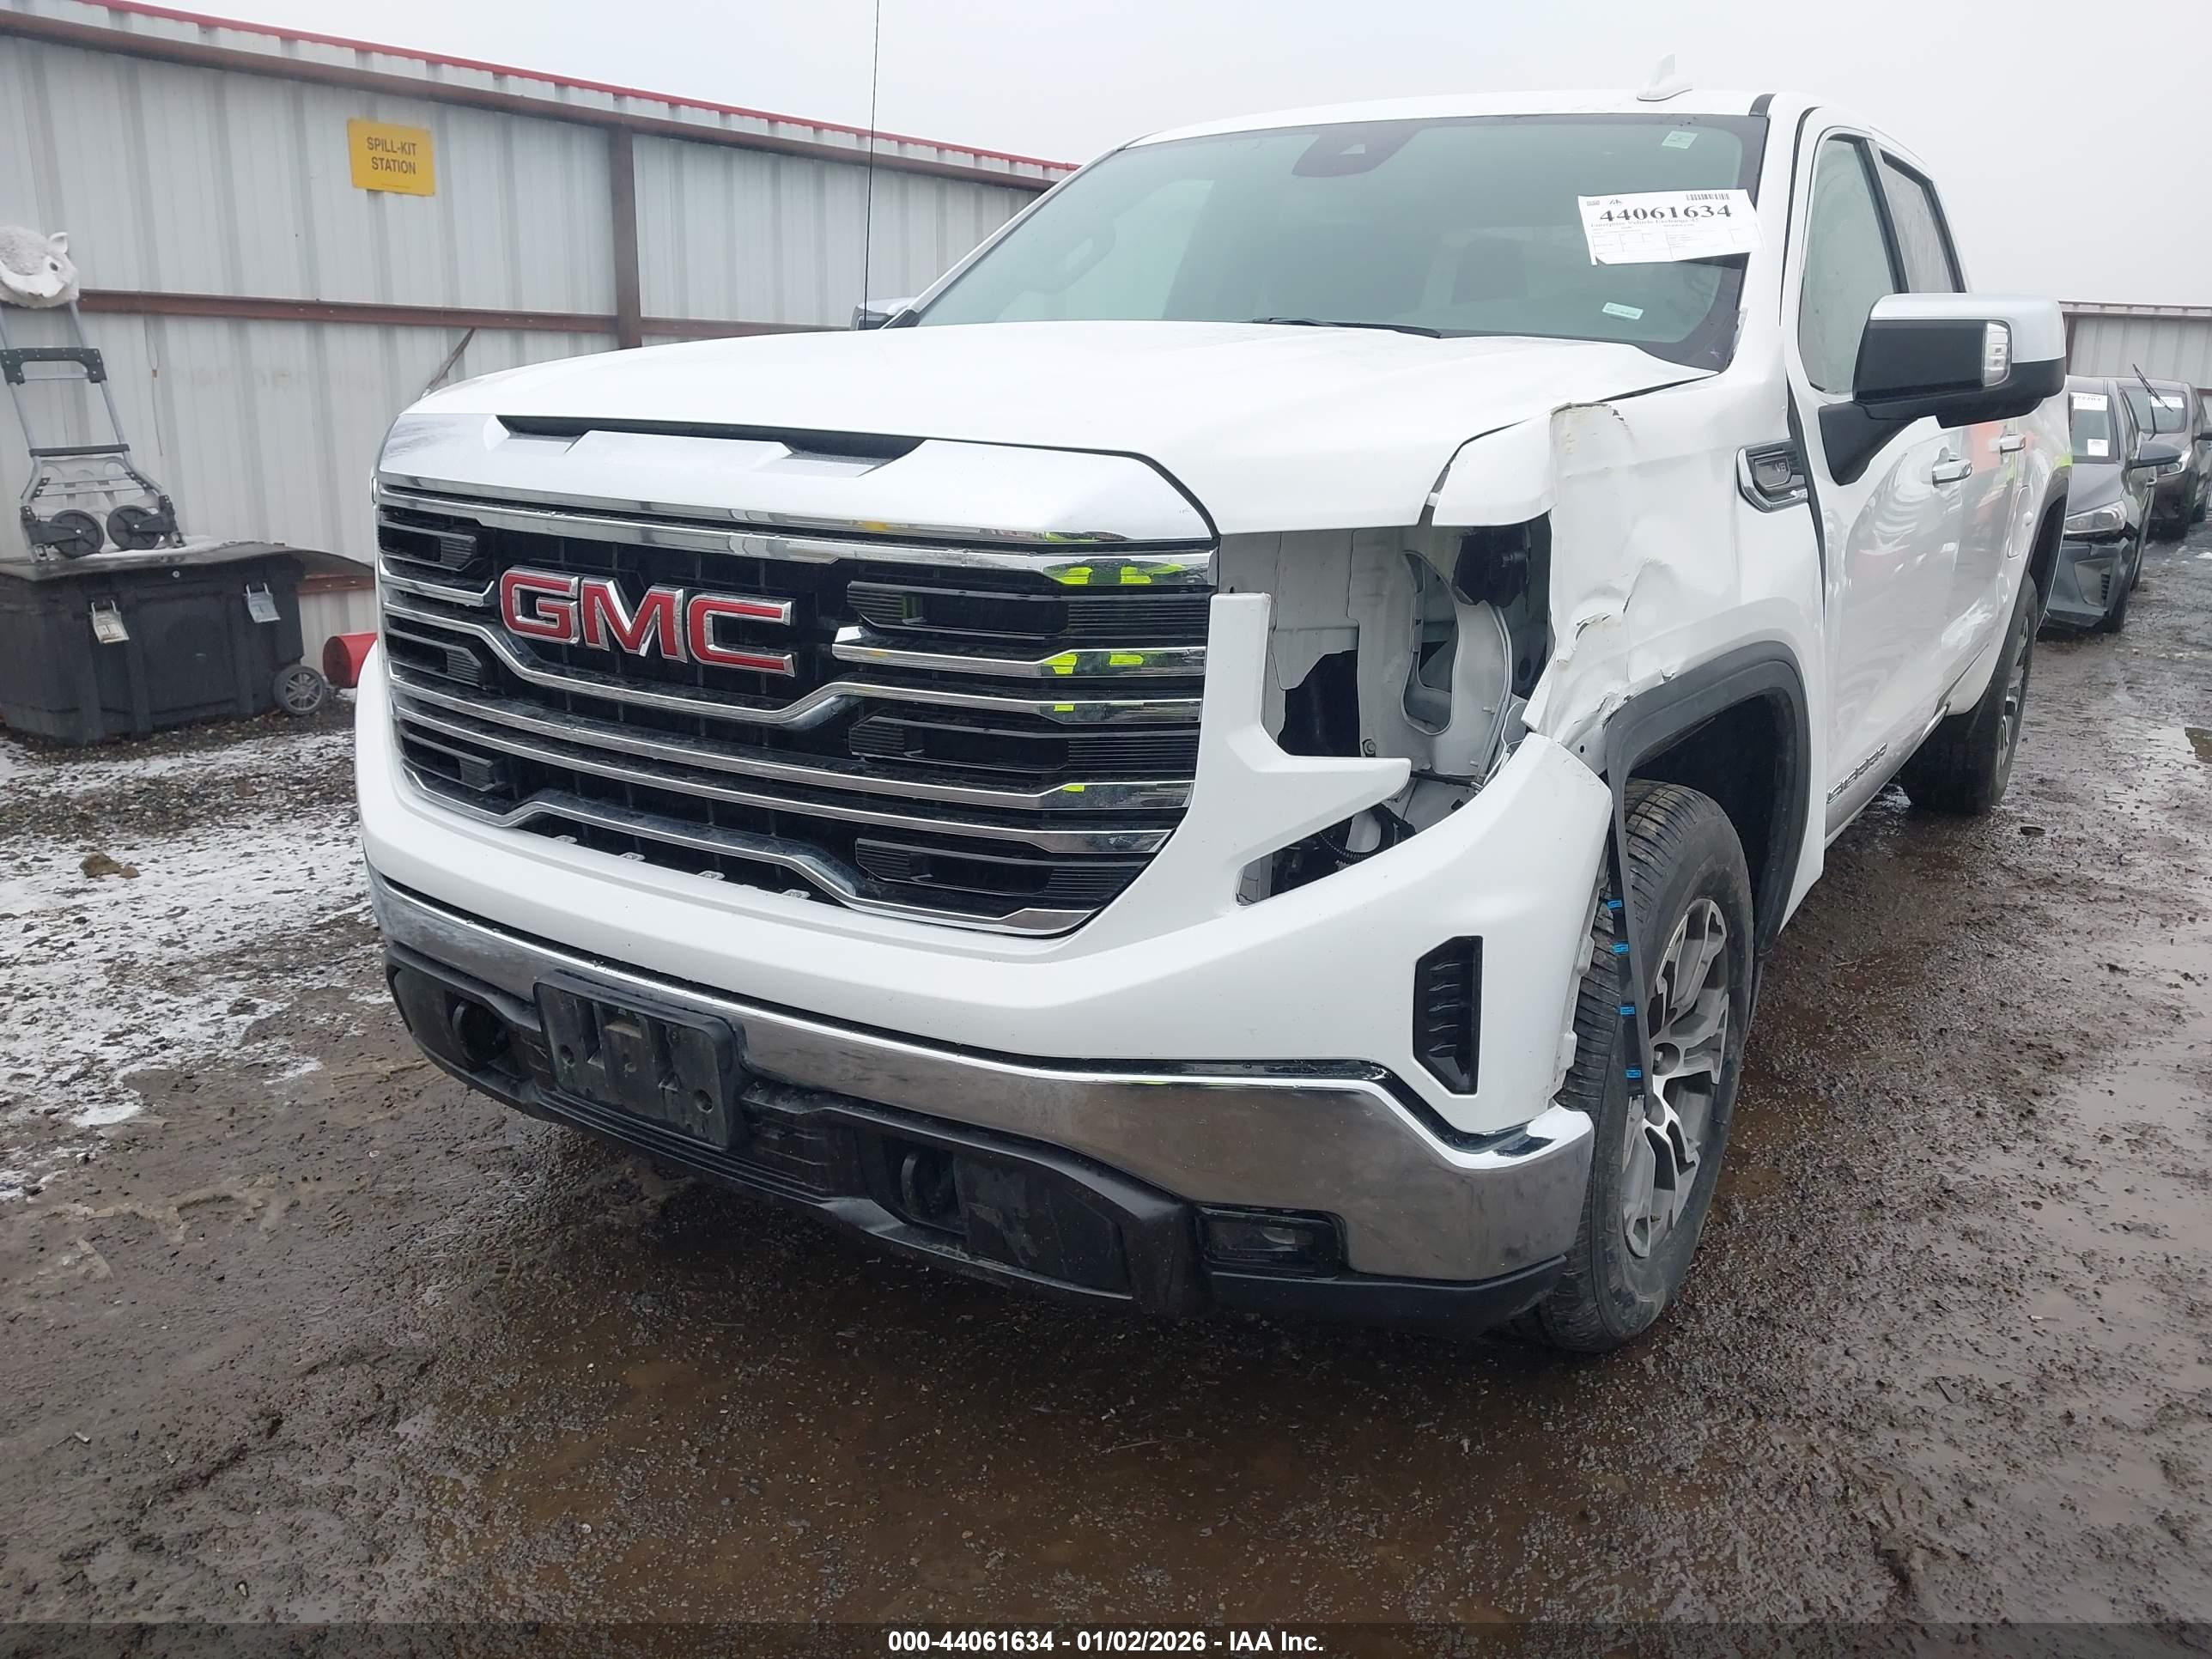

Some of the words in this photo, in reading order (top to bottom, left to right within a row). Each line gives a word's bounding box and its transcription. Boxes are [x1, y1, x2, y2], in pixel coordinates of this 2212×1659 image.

[366, 137, 417, 156] SPILL-KIT
[371, 156, 416, 174] STATION
[1600, 204, 1733, 222] 44061634
[500, 565, 796, 678] GMC
